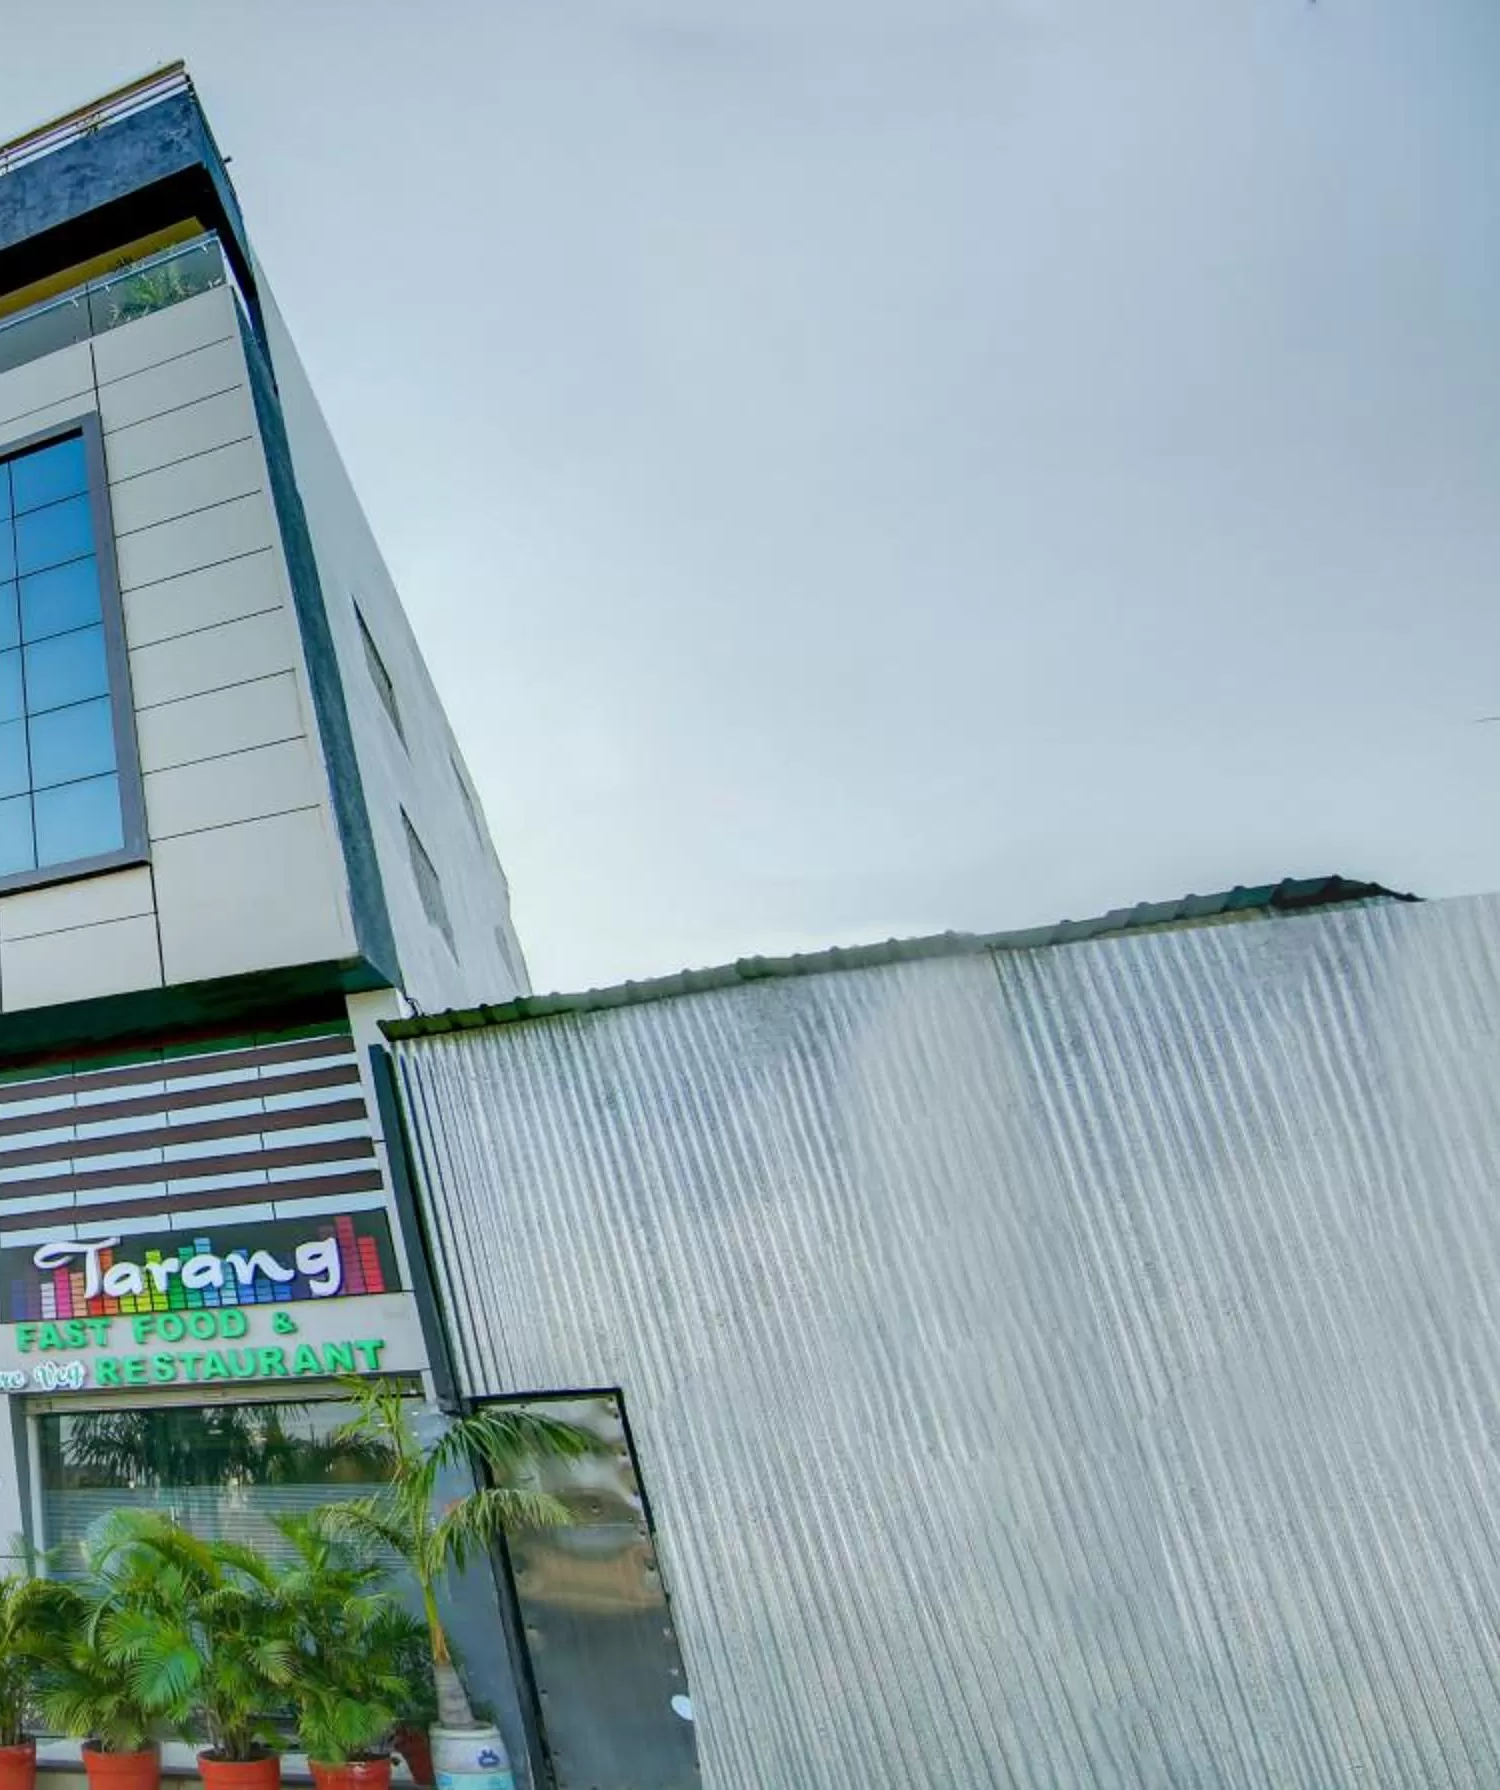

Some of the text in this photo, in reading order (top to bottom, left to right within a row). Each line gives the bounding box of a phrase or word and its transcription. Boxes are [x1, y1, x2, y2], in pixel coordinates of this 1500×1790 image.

[33, 1236, 343, 1299] Tarang
[15, 1308, 298, 1353] FAST FOOD &
[33, 1360, 86, 1392] Veg
[95, 1339, 386, 1387] RESTAURANT
